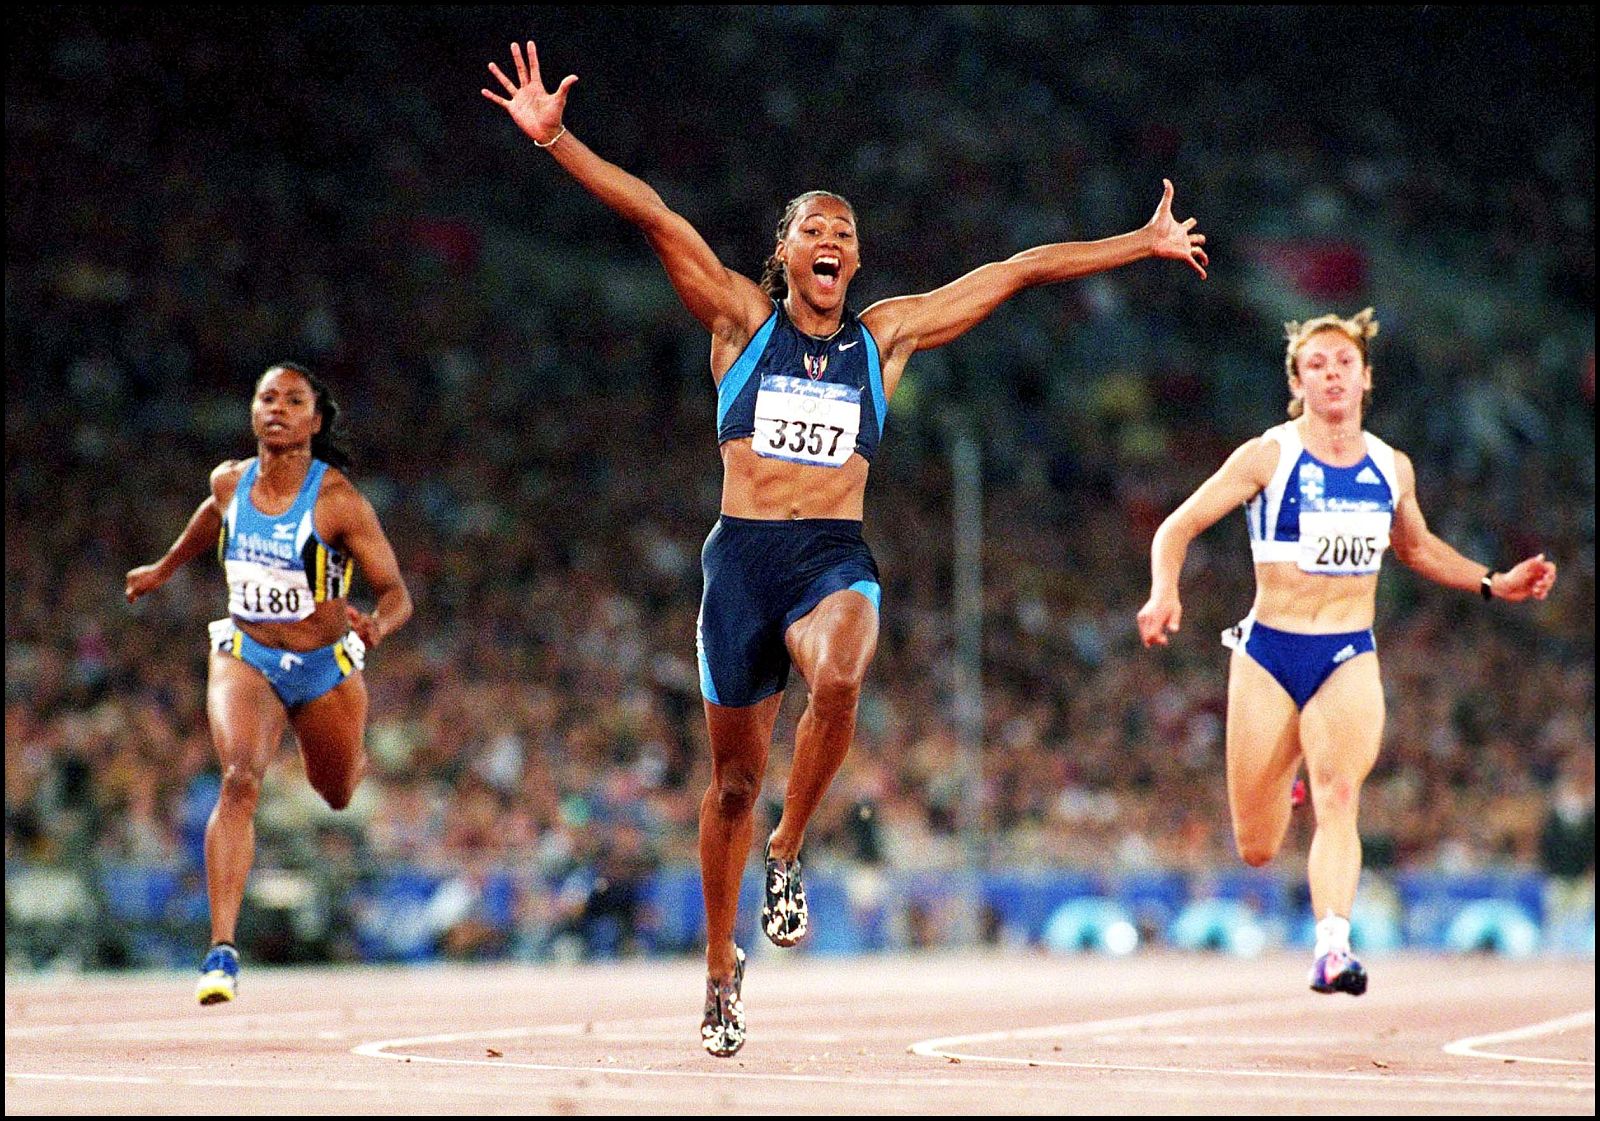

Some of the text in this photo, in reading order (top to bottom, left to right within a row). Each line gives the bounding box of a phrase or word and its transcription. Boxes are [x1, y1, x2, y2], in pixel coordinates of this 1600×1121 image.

[769, 419, 844, 457] 3357
[1316, 536, 1376, 566] 2005
[242, 582, 299, 613] 1180
